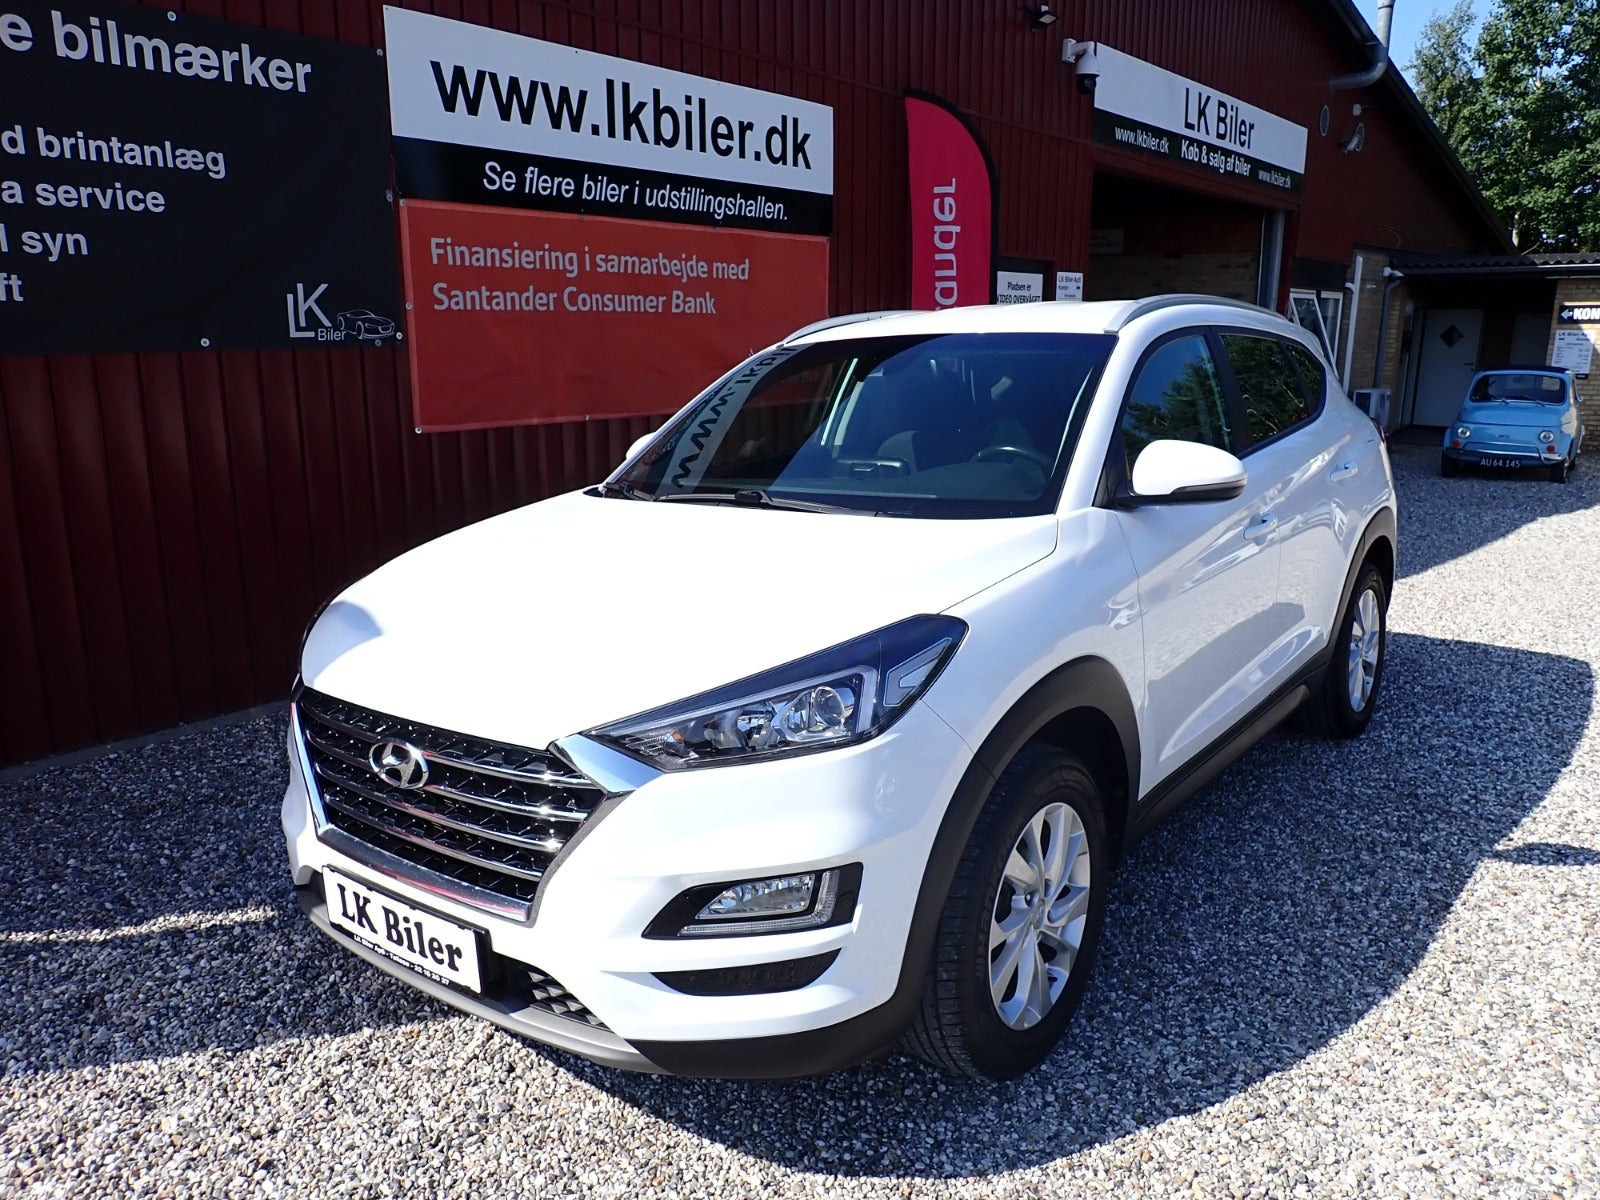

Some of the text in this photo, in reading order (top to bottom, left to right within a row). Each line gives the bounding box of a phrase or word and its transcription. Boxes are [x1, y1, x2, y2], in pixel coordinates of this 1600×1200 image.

[51, 10, 311, 92] bilmærker
[429, 59, 813, 170] www.lkbiler.dk
[1184, 87, 1254, 150] LK Biler
[37, 127, 226, 179] brintanlæg
[1115, 126, 1169, 154] www.lkbiler.dk
[1181, 139, 1251, 177] Køb & salg af biler
[35, 182, 166, 213] service
[483, 161, 789, 221] Se flere biler i udstillingshallen.
[21, 229, 88, 262] syn
[430, 237, 749, 282] Finansiering i samarbejde med
[933, 177, 961, 309] ander
[286, 282, 332, 338] LK
[433, 282, 716, 314] Santander Consumer Bank
[317, 328, 346, 341] Biler
[1480, 457, 1492, 466] AU
[337, 883, 463, 972] LK Biler
